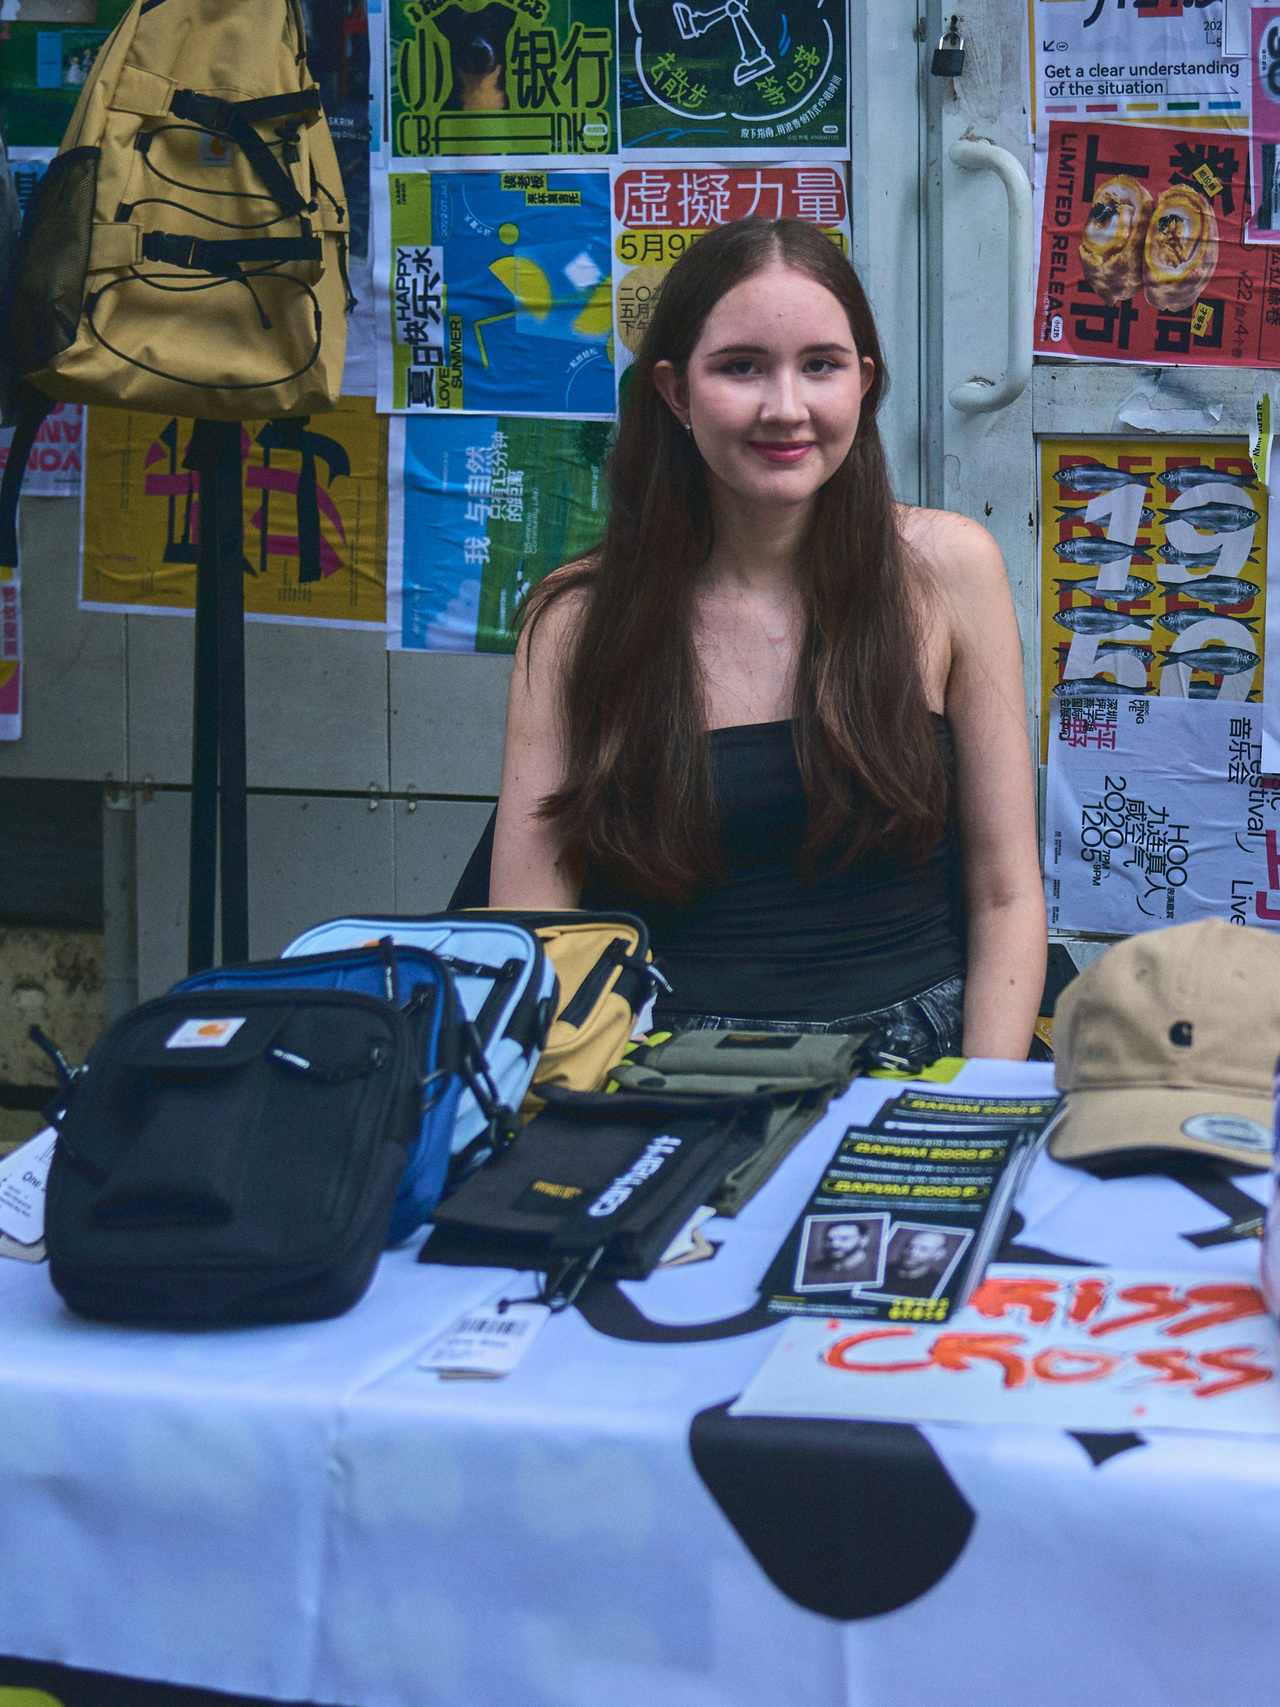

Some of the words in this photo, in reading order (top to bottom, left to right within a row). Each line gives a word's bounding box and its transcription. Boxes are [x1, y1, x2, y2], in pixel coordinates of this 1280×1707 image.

[510, 24, 610, 108] 银行
[1045, 65, 1071, 78] Get
[1075, 69, 1085, 78] a
[1089, 64, 1125, 77] clear
[1129, 61, 1240, 78] understanding
[1050, 82, 1065, 96] of
[1070, 82, 1094, 96] the
[1098, 81, 1164, 95] situation
[1053, 134, 1078, 227] LIMITED
[396, 248, 412, 321] HAPPY
[439, 368, 450, 408] LOVE
[451, 321, 462, 389] SUMMER
[1136, 699, 1144, 724] PING
[1228, 717, 1251, 784] 音乐会
[1081, 800, 1103, 862] 12.05
[1104, 776, 1127, 849] 2020
[1144, 805, 1169, 898] 九连真人
[1166, 825, 1189, 887] HOO
